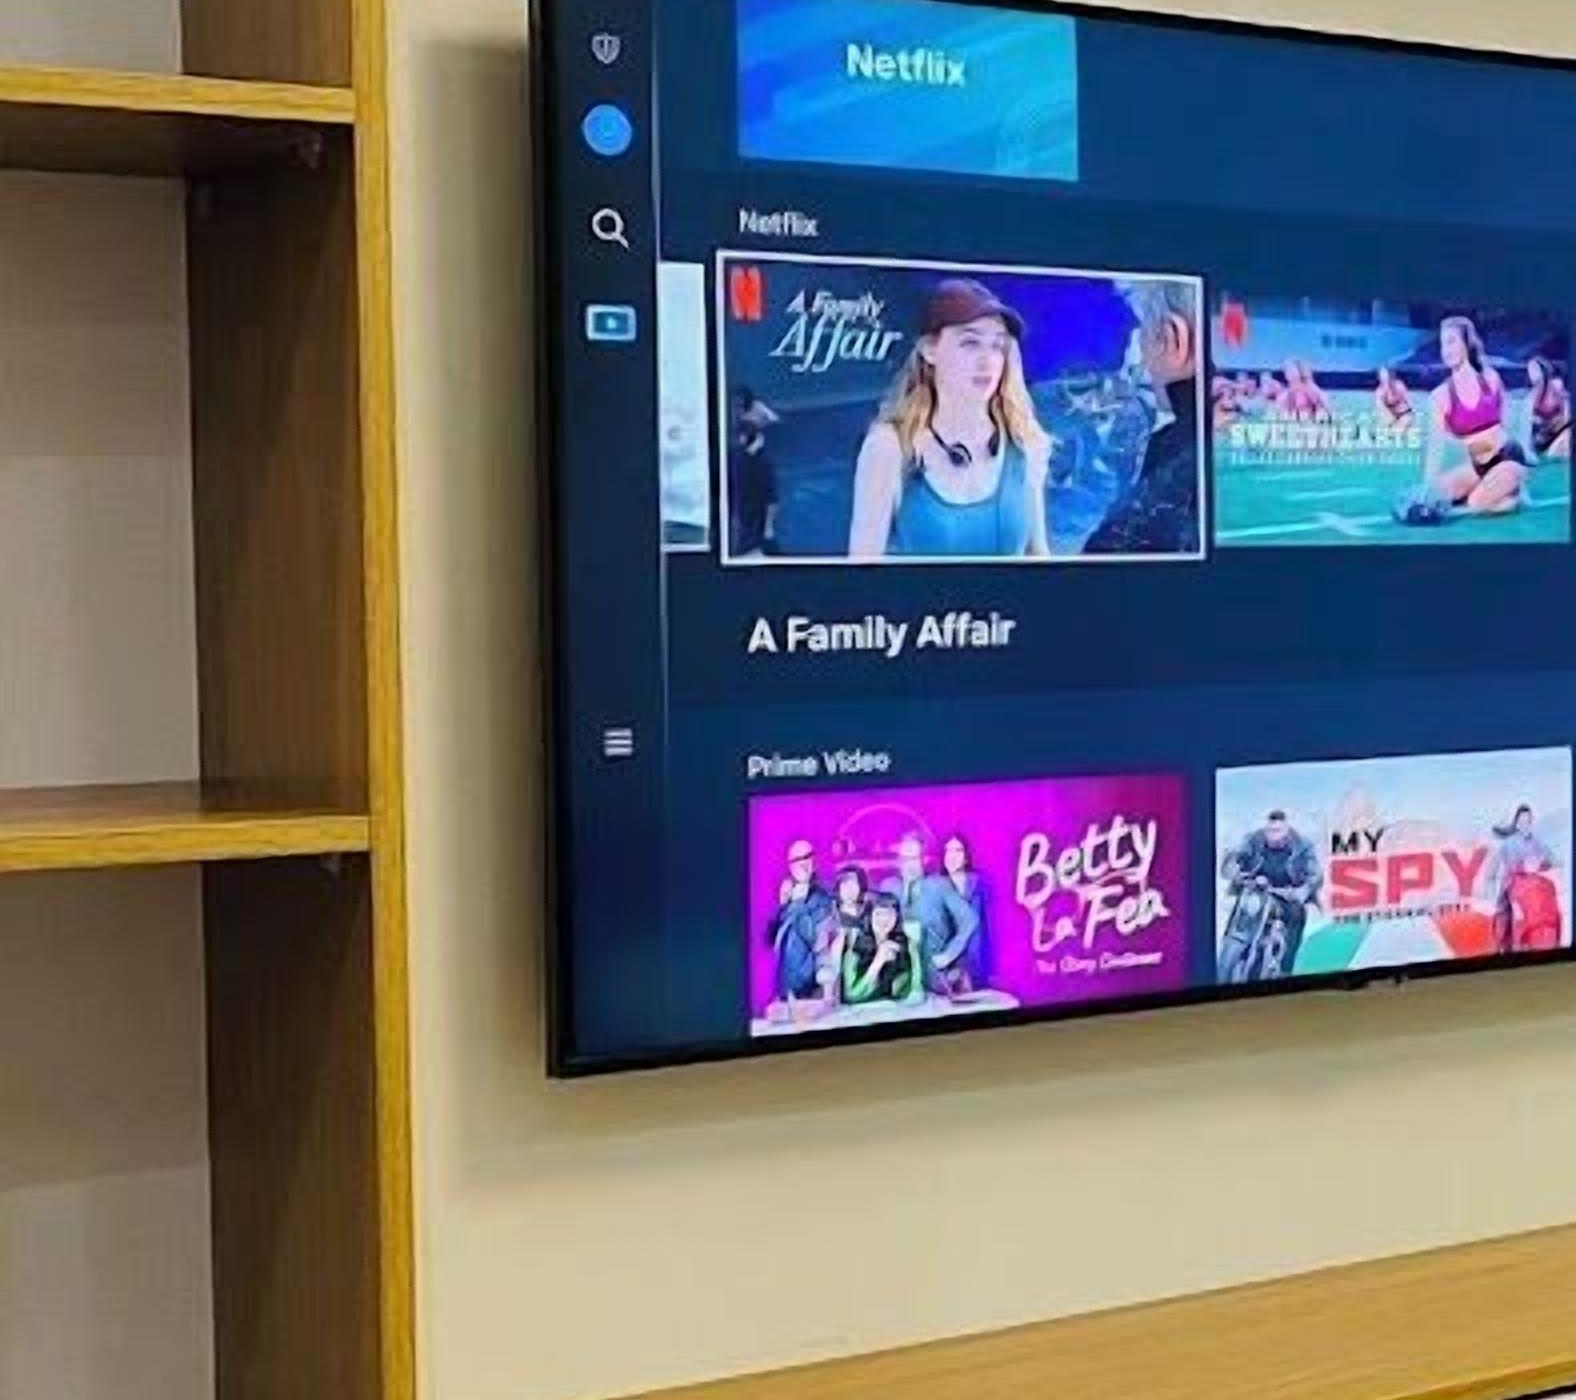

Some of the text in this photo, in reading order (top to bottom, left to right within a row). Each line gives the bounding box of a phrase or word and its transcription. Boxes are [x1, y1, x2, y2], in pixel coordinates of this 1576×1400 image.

[845, 43, 967, 88] Netflix
[738, 207, 820, 238] Netflix
[786, 289, 807, 314] A
[766, 311, 904, 374] Affair
[747, 612, 1017, 659] A Family Affair
[747, 749, 892, 780] Prime Video
[1016, 813, 1158, 908] Betty
[1331, 827, 1385, 855] MY
[1329, 844, 1490, 910] SPY
